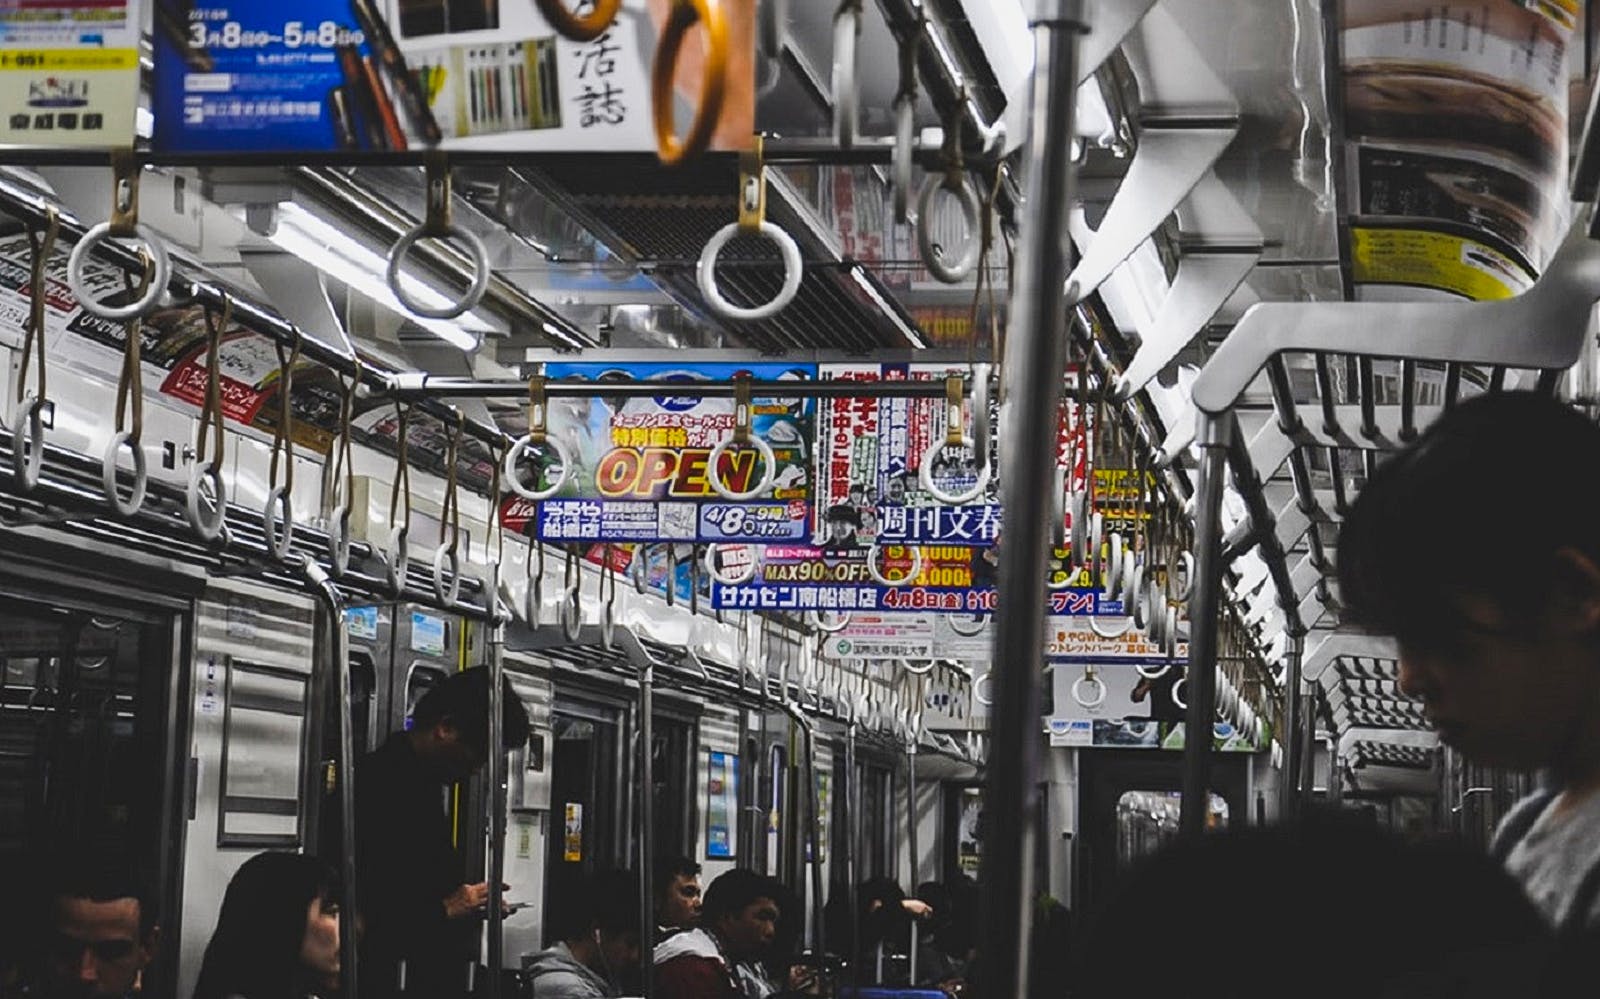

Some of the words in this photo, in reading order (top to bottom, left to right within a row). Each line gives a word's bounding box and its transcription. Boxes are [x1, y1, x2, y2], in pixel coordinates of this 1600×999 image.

[597, 448, 757, 498] OPEN
[877, 506, 1001, 540] 週刊文春
[720, 586, 878, 609] サカゼン南船橋店
[1047, 592, 1095, 613] プン!
